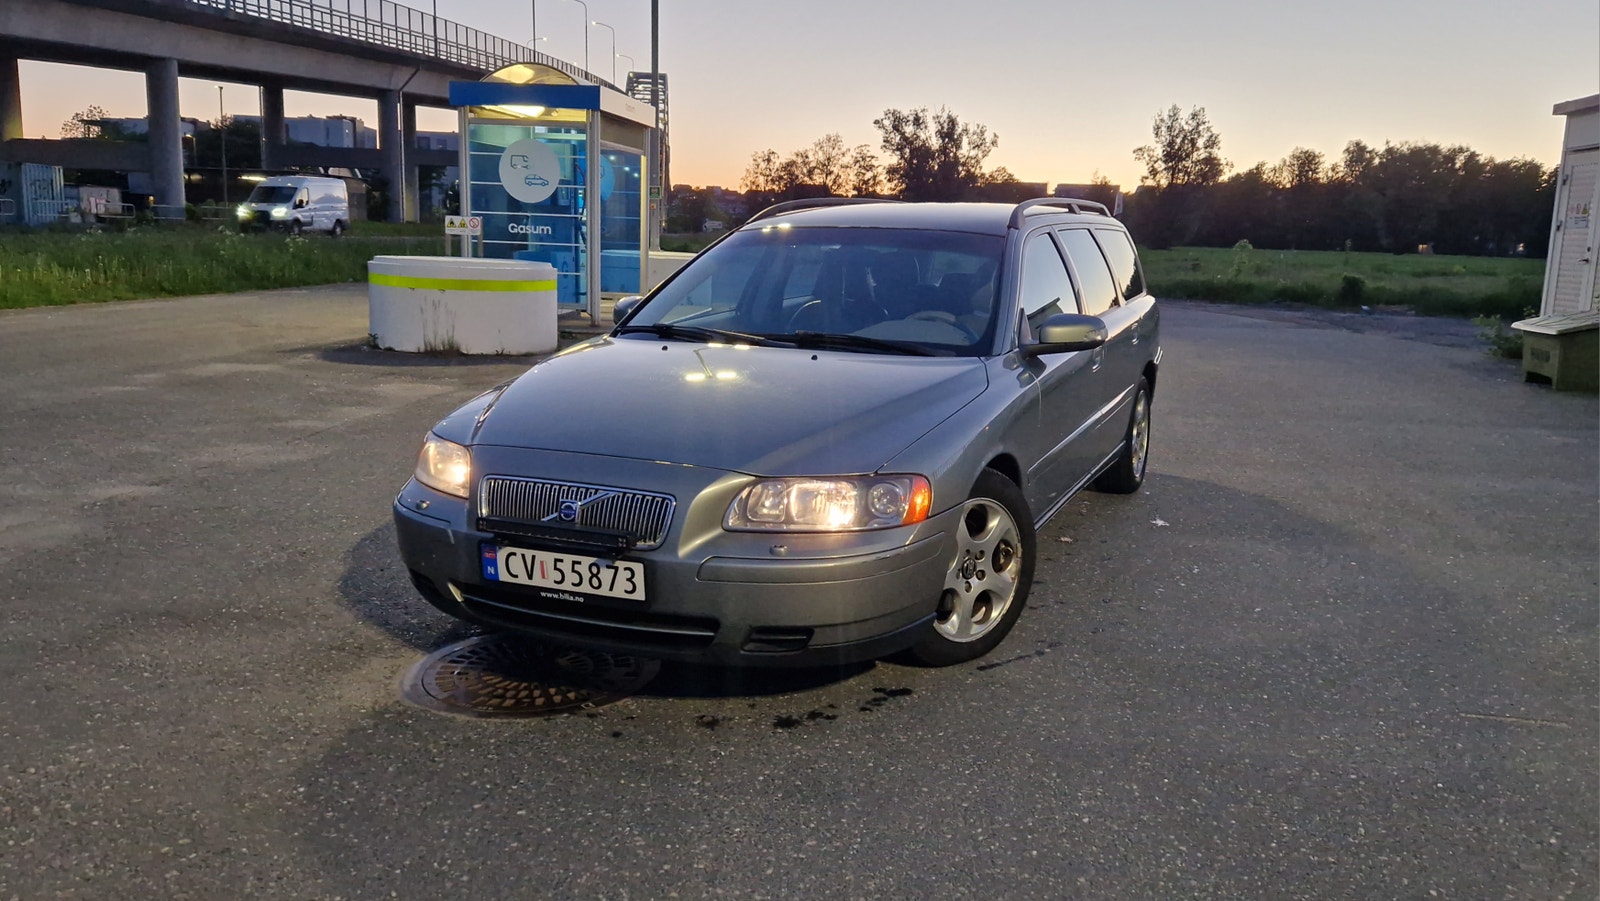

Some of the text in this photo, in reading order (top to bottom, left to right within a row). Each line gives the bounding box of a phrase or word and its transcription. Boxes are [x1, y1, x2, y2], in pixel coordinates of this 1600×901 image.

[508, 223, 552, 235] Gasum
[487, 565, 495, 575] N
[505, 552, 637, 595] CV 55873
